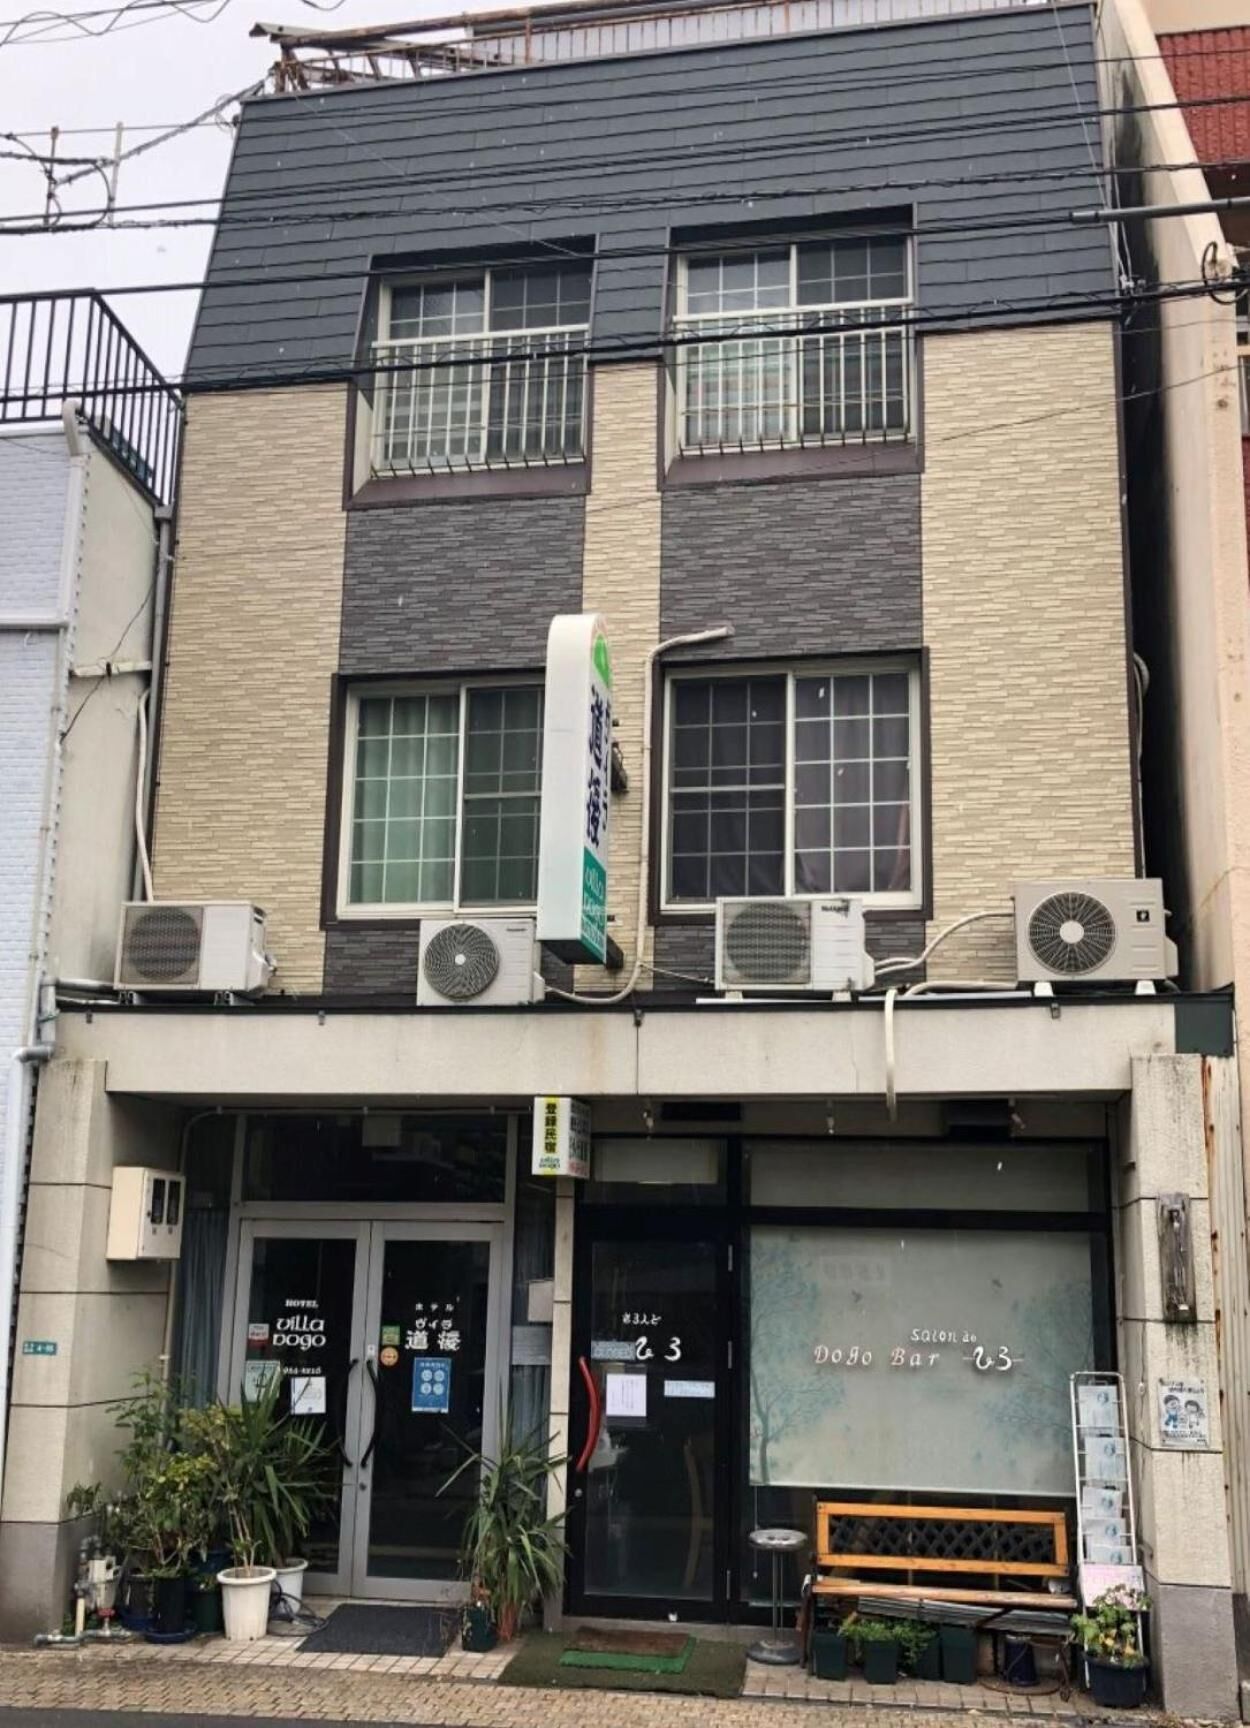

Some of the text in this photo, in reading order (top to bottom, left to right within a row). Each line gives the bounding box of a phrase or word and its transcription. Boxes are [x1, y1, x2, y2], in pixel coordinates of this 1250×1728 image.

[285, 1299, 319, 1308] HOTEL
[415, 1317, 453, 1330] ヴィラ
[405, 1329, 462, 1352] 道後
[813, 1345, 873, 1366] Dogo
[890, 1347, 941, 1367] Bar
